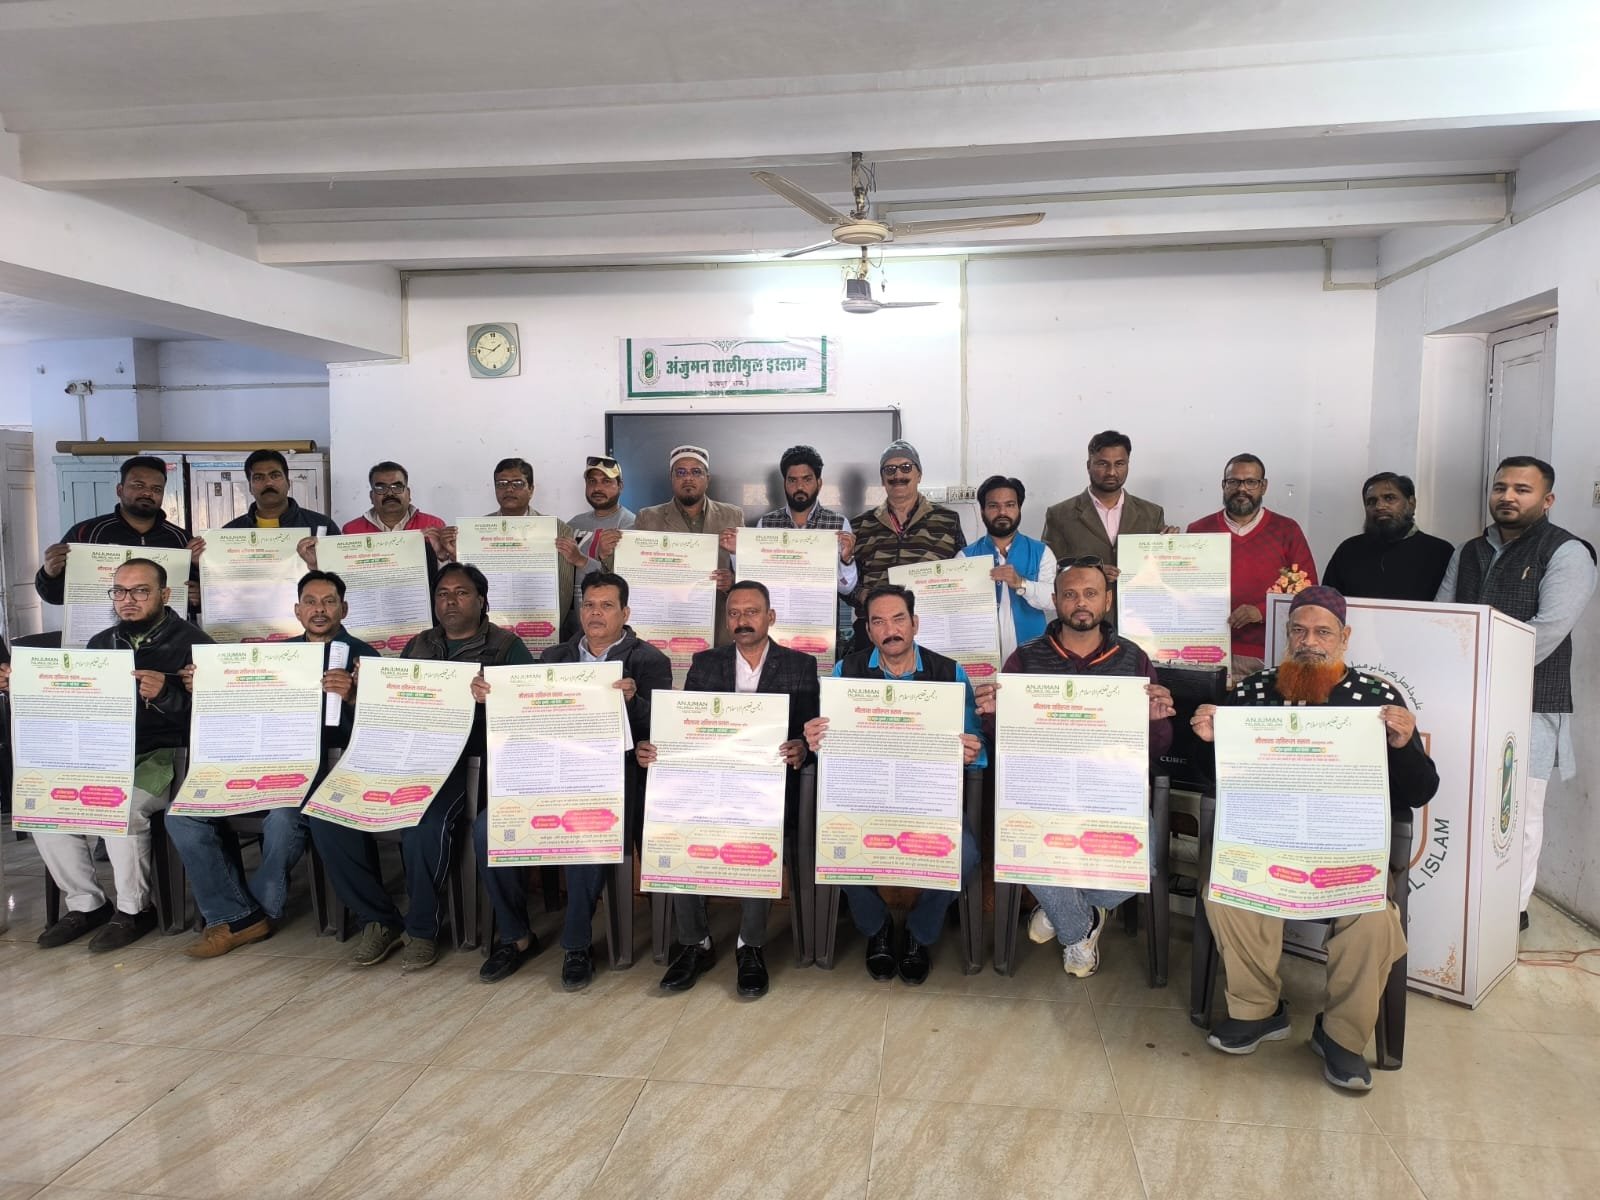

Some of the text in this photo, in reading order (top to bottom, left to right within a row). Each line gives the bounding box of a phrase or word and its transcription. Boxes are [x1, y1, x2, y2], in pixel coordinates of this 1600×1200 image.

[666, 354, 808, 379] अंजुमन तालीमुल इस्लाम
[1420, 817, 1450, 878] ISLAM
